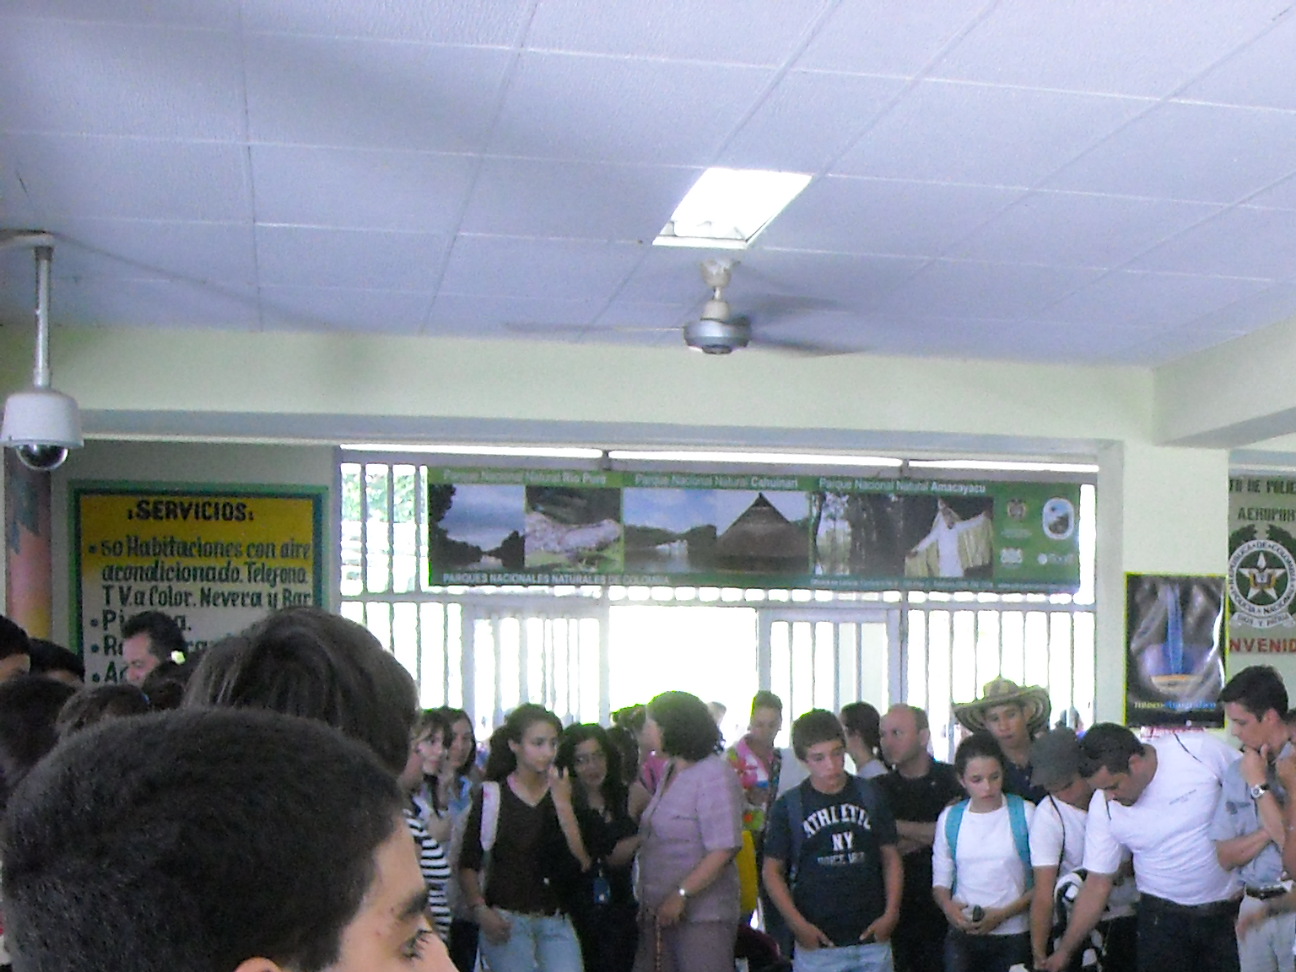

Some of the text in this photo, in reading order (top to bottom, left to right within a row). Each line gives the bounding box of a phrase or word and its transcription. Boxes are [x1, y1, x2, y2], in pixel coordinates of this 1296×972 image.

[127, 535, 243, 559] Habitaciones
[246, 541, 276, 558] con
[443, 574, 488, 583] PARQUES
[490, 574, 549, 584] NACIONALES
[552, 574, 605, 584] NATURALES
[200, 587, 262, 608] Nevera
[267, 591, 277, 609] y
[832, 831, 853, 851] NY
